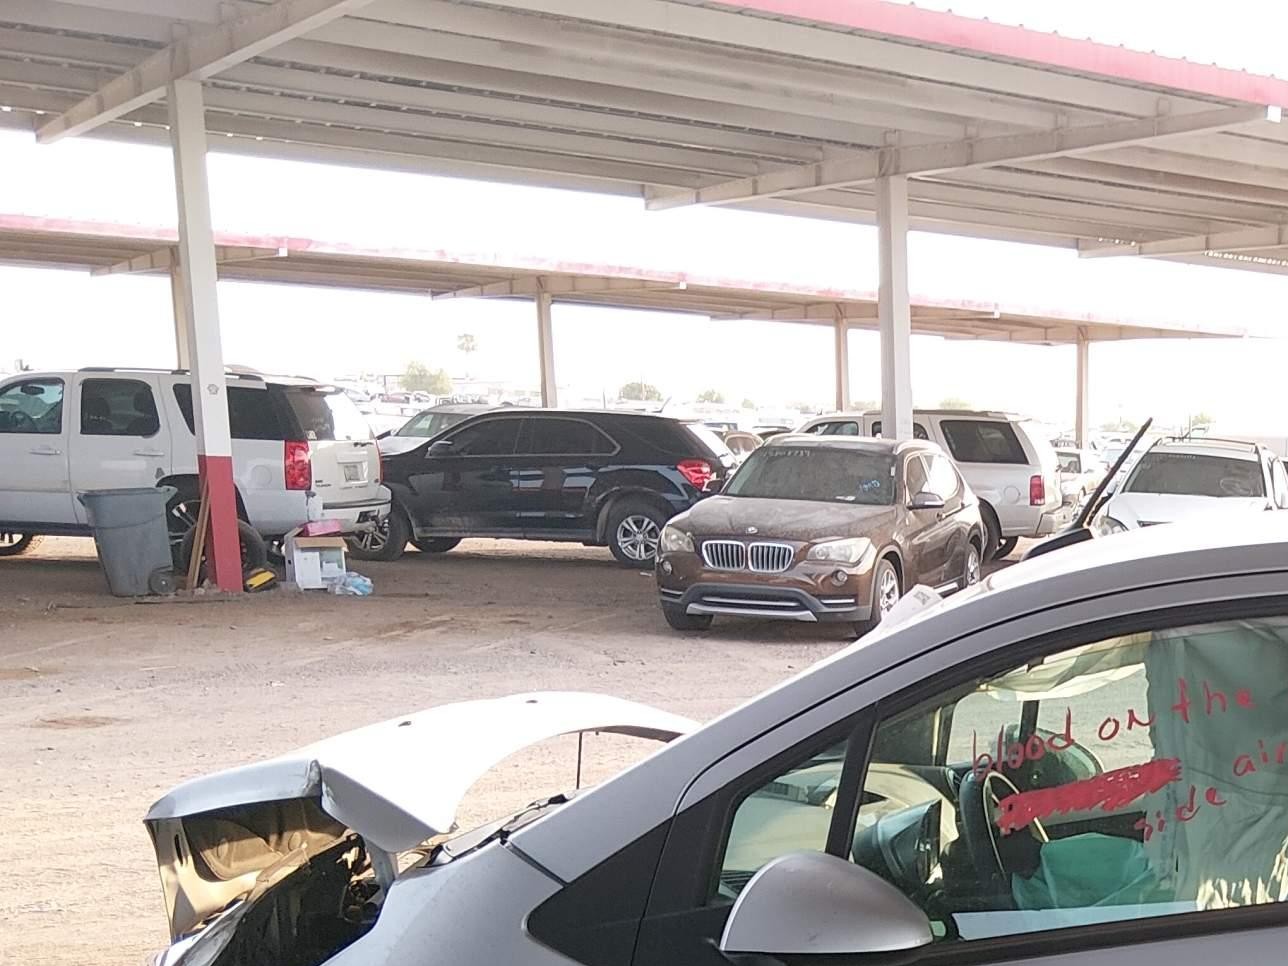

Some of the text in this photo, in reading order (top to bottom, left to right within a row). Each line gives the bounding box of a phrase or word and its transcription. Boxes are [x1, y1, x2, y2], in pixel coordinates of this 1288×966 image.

[973, 706, 1075, 782] blood
[1098, 708, 1156, 741] on
[1171, 677, 1257, 724] the
[1134, 784, 1228, 842] side
